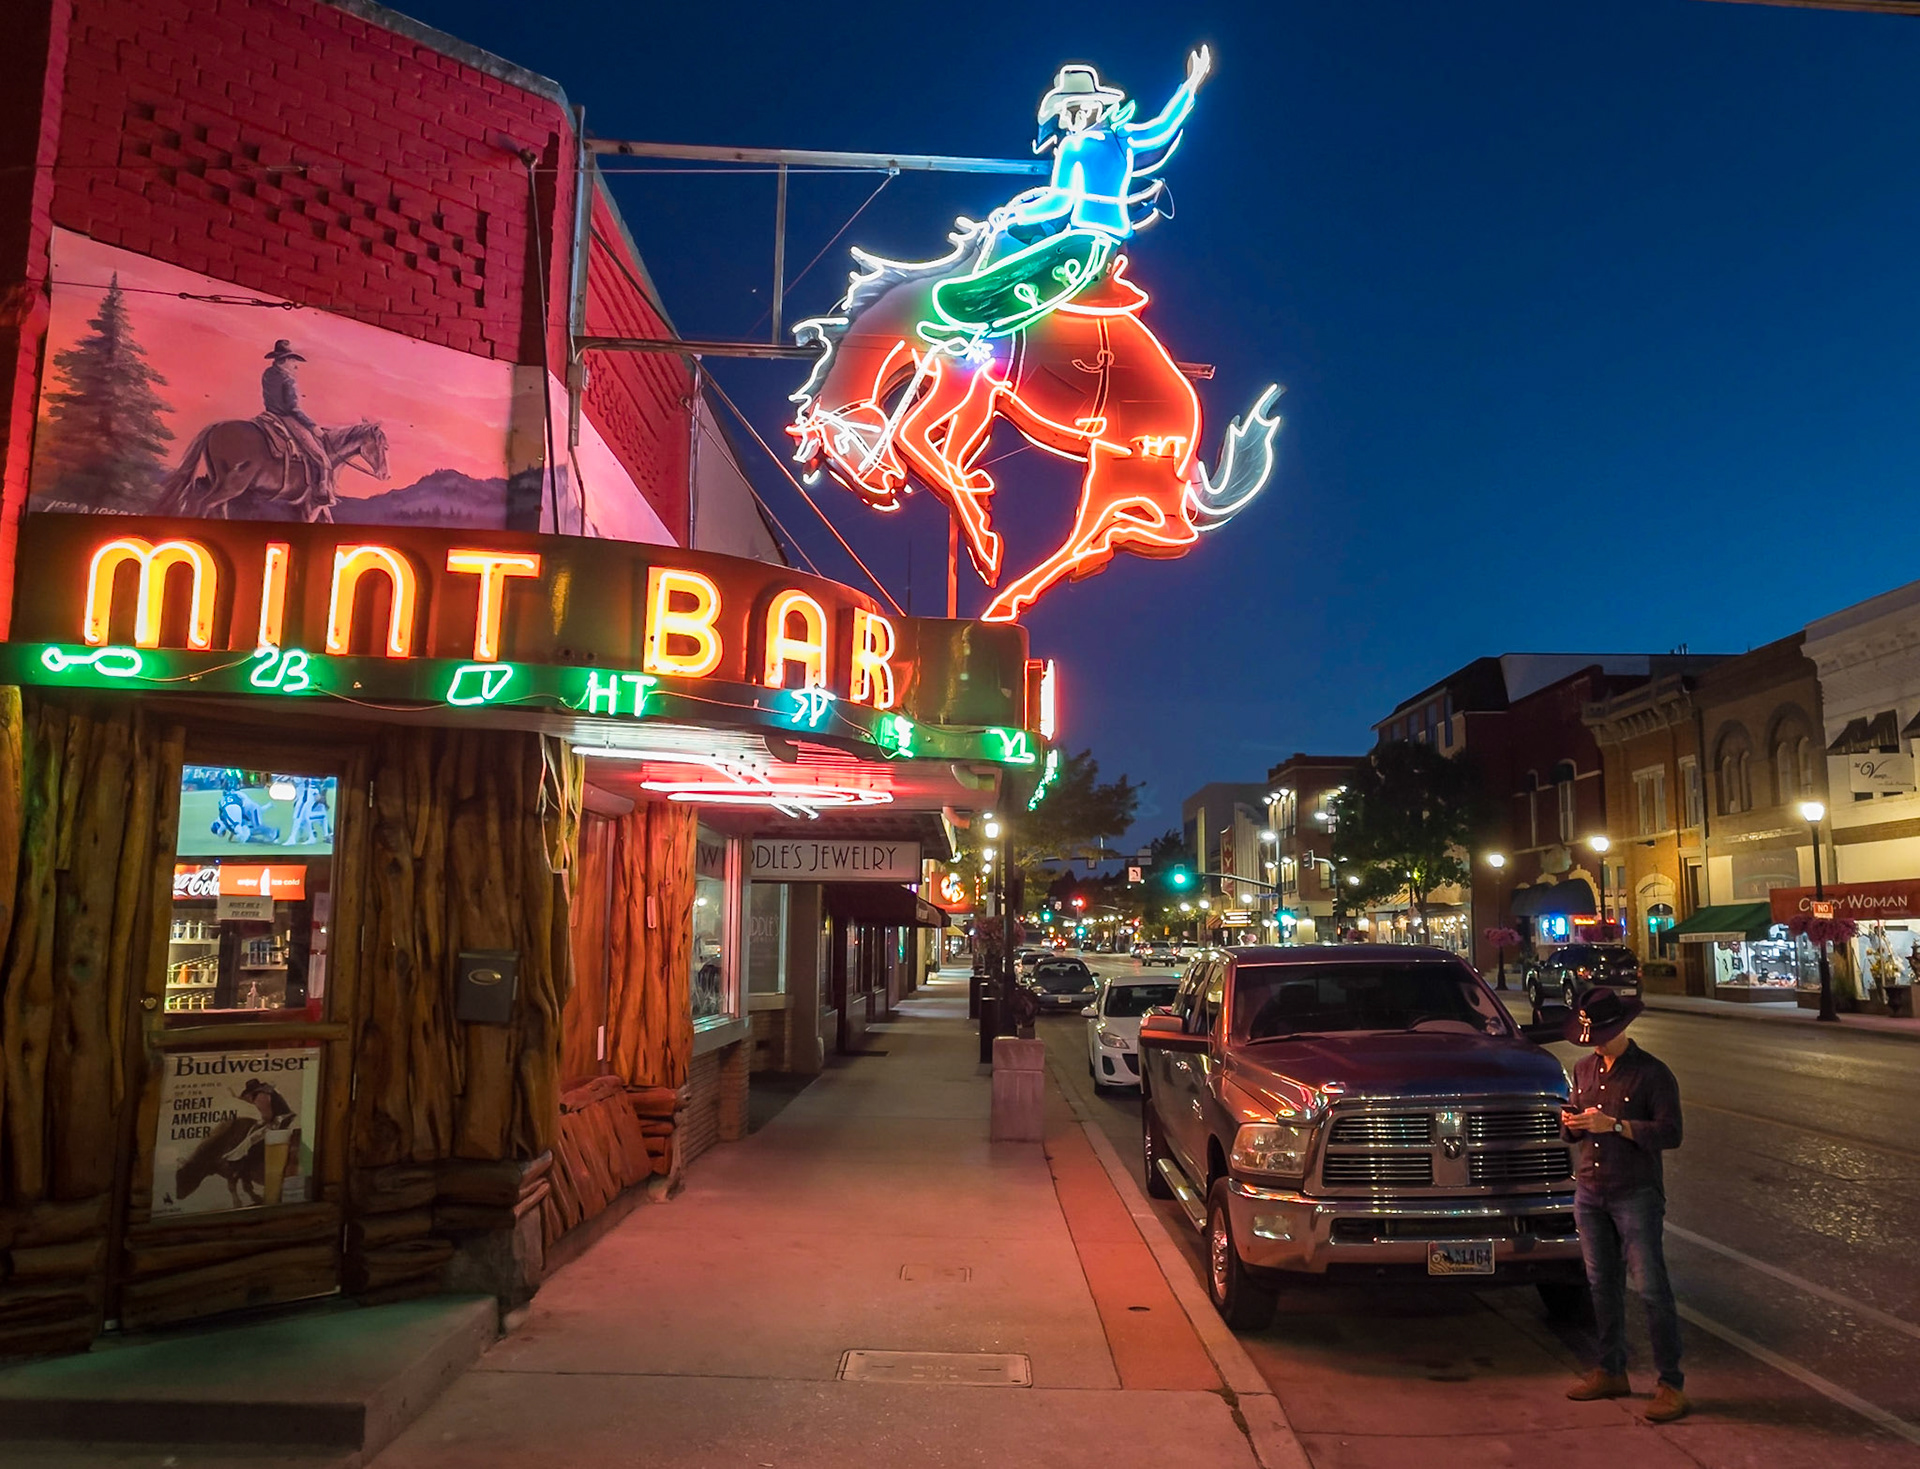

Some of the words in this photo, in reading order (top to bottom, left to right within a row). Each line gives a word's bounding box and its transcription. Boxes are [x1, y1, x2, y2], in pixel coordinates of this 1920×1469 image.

[83, 536, 541, 662] MINT
[642, 565, 895, 710] BAR
[809, 843, 897, 871] JEWELRY
[1817, 904, 1829, 913] NO
[1847, 894, 1908, 910] WOMAN
[173, 1053, 310, 1077] Budweiser
[173, 1097, 214, 1111] GREAT
[171, 1110, 238, 1126] AMERICAN
[170, 1126, 212, 1141] LAGER
